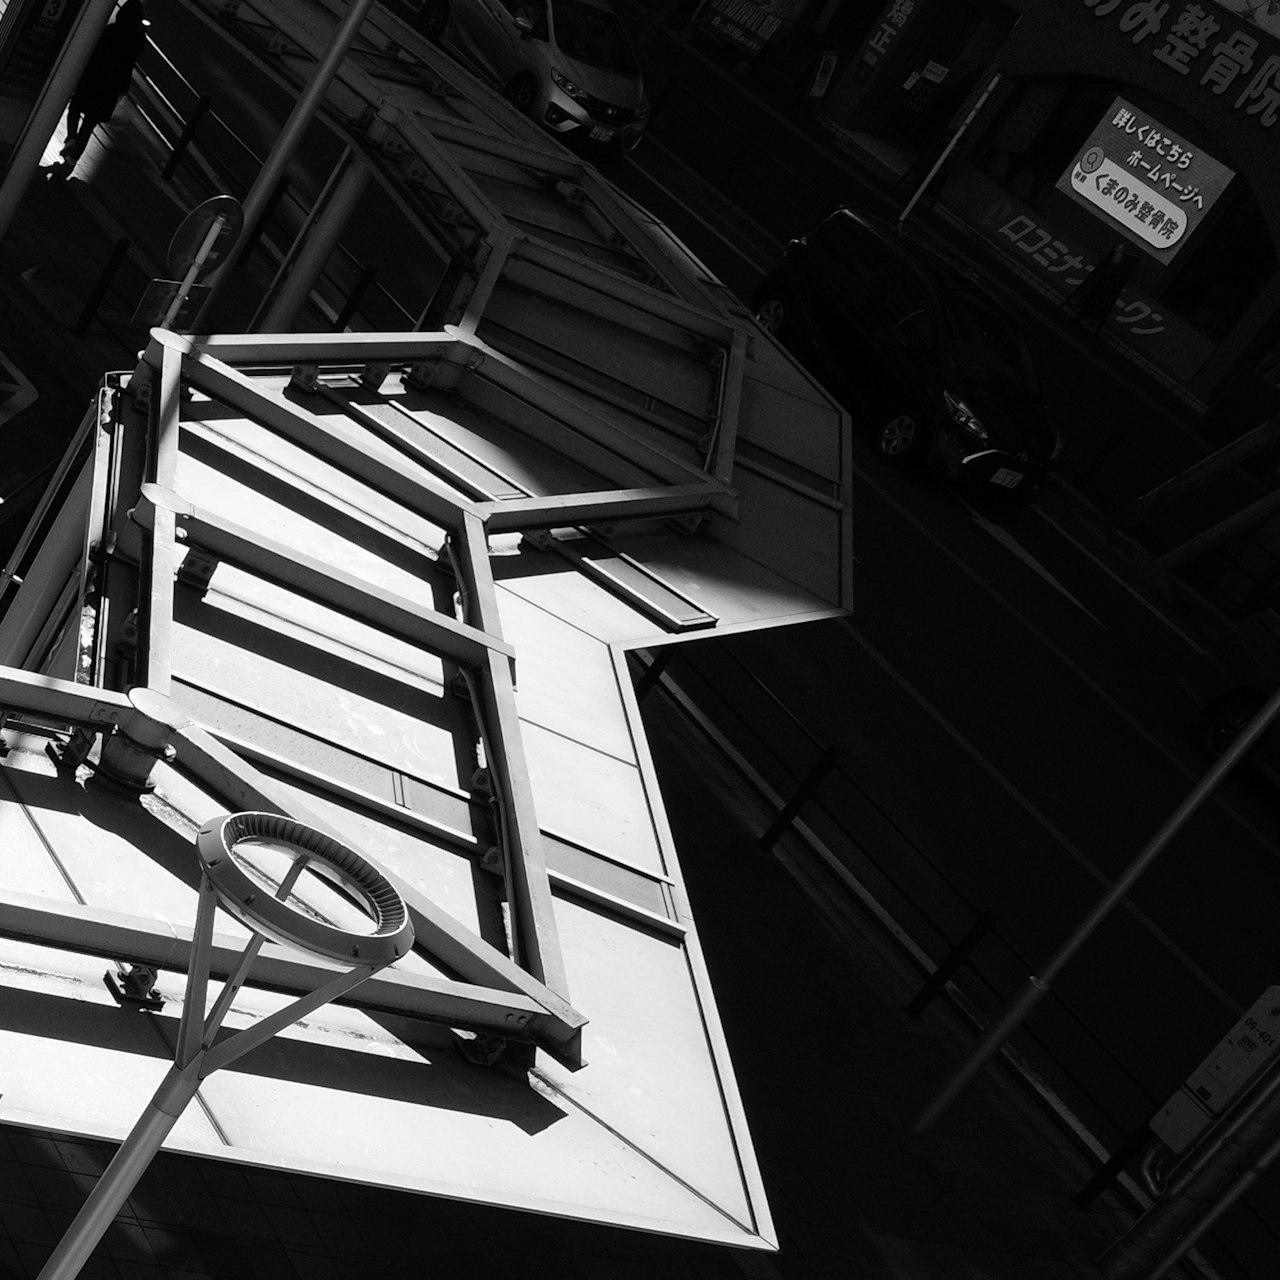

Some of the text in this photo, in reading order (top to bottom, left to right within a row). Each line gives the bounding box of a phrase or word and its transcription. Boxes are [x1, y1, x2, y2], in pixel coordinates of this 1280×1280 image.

[47, 0, 61, 17] 3
[1111, 107, 1193, 169] 詳しくはこちら
[1094, 172, 1180, 240] くまのみ整骨院
[1126, 149, 1204, 210] ホームページへ
[1244, 1016, 1275, 1048] 09-401
